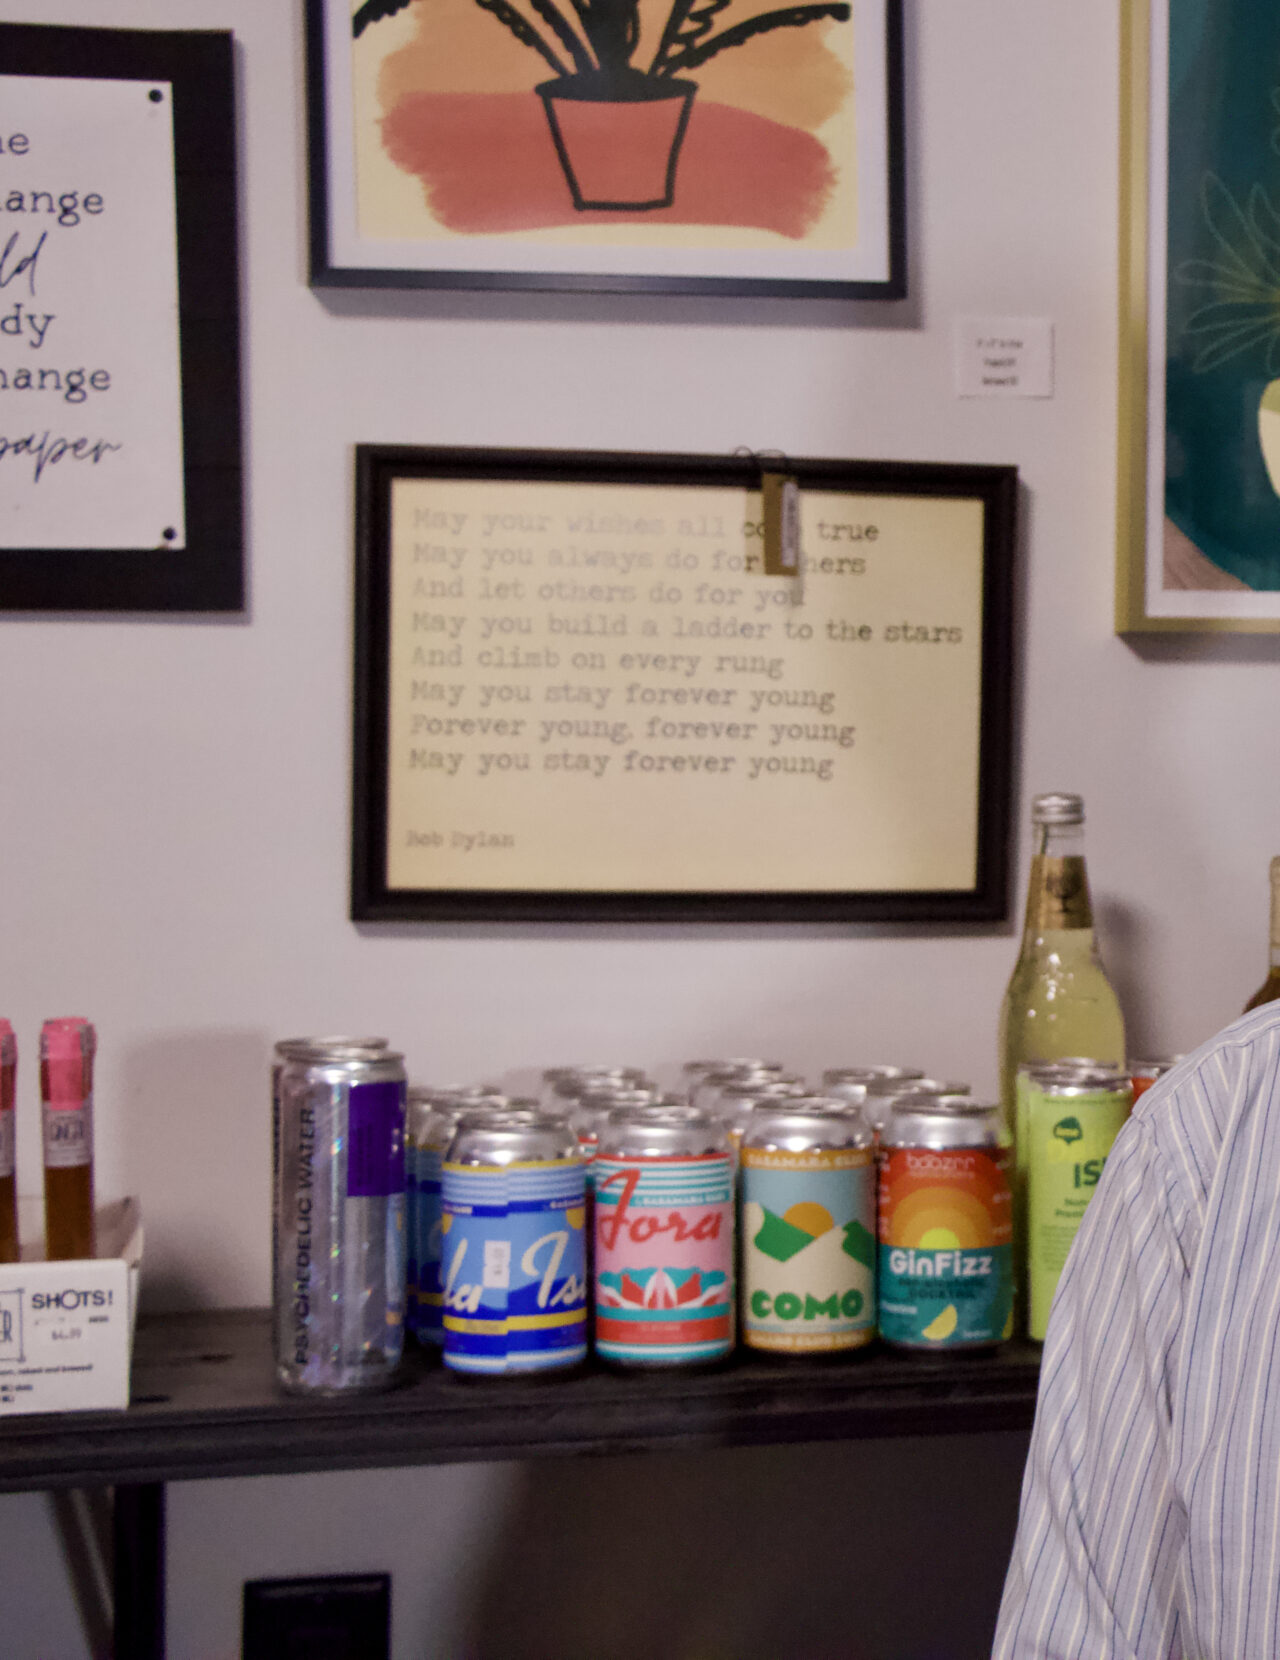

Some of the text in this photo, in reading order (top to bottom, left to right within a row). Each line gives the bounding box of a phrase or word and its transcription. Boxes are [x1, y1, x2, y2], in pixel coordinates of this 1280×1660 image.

[0, 132, 31, 156] e
[0, 189, 105, 228] ange
[413, 509, 468, 536] May
[482, 512, 550, 537] your
[817, 520, 880, 542] true
[412, 543, 468, 570] May
[482, 548, 533, 571] you
[665, 548, 700, 571] do
[711, 550, 760, 574] for
[803, 551, 867, 576] hers
[412, 576, 464, 599] And
[650, 582, 684, 603] do
[693, 582, 744, 606] for
[755, 586, 806, 612] you
[411, 612, 965, 645] May you build a ladder to the stars
[411, 645, 785, 680] And climb on every rung
[410, 679, 836, 715] May you stay forever young
[410, 714, 527, 737] Forever
[646, 714, 758, 741] forever
[769, 721, 857, 749] young
[408, 749, 835, 782] May you stay forever young
[298, 1108, 315, 1190] WATER
[1073, 1156, 1107, 1189] IS
[890, 1248, 993, 1278] GinFizz
[31, 1288, 114, 1311] SHOTS!
[750, 1288, 865, 1321] COMO
